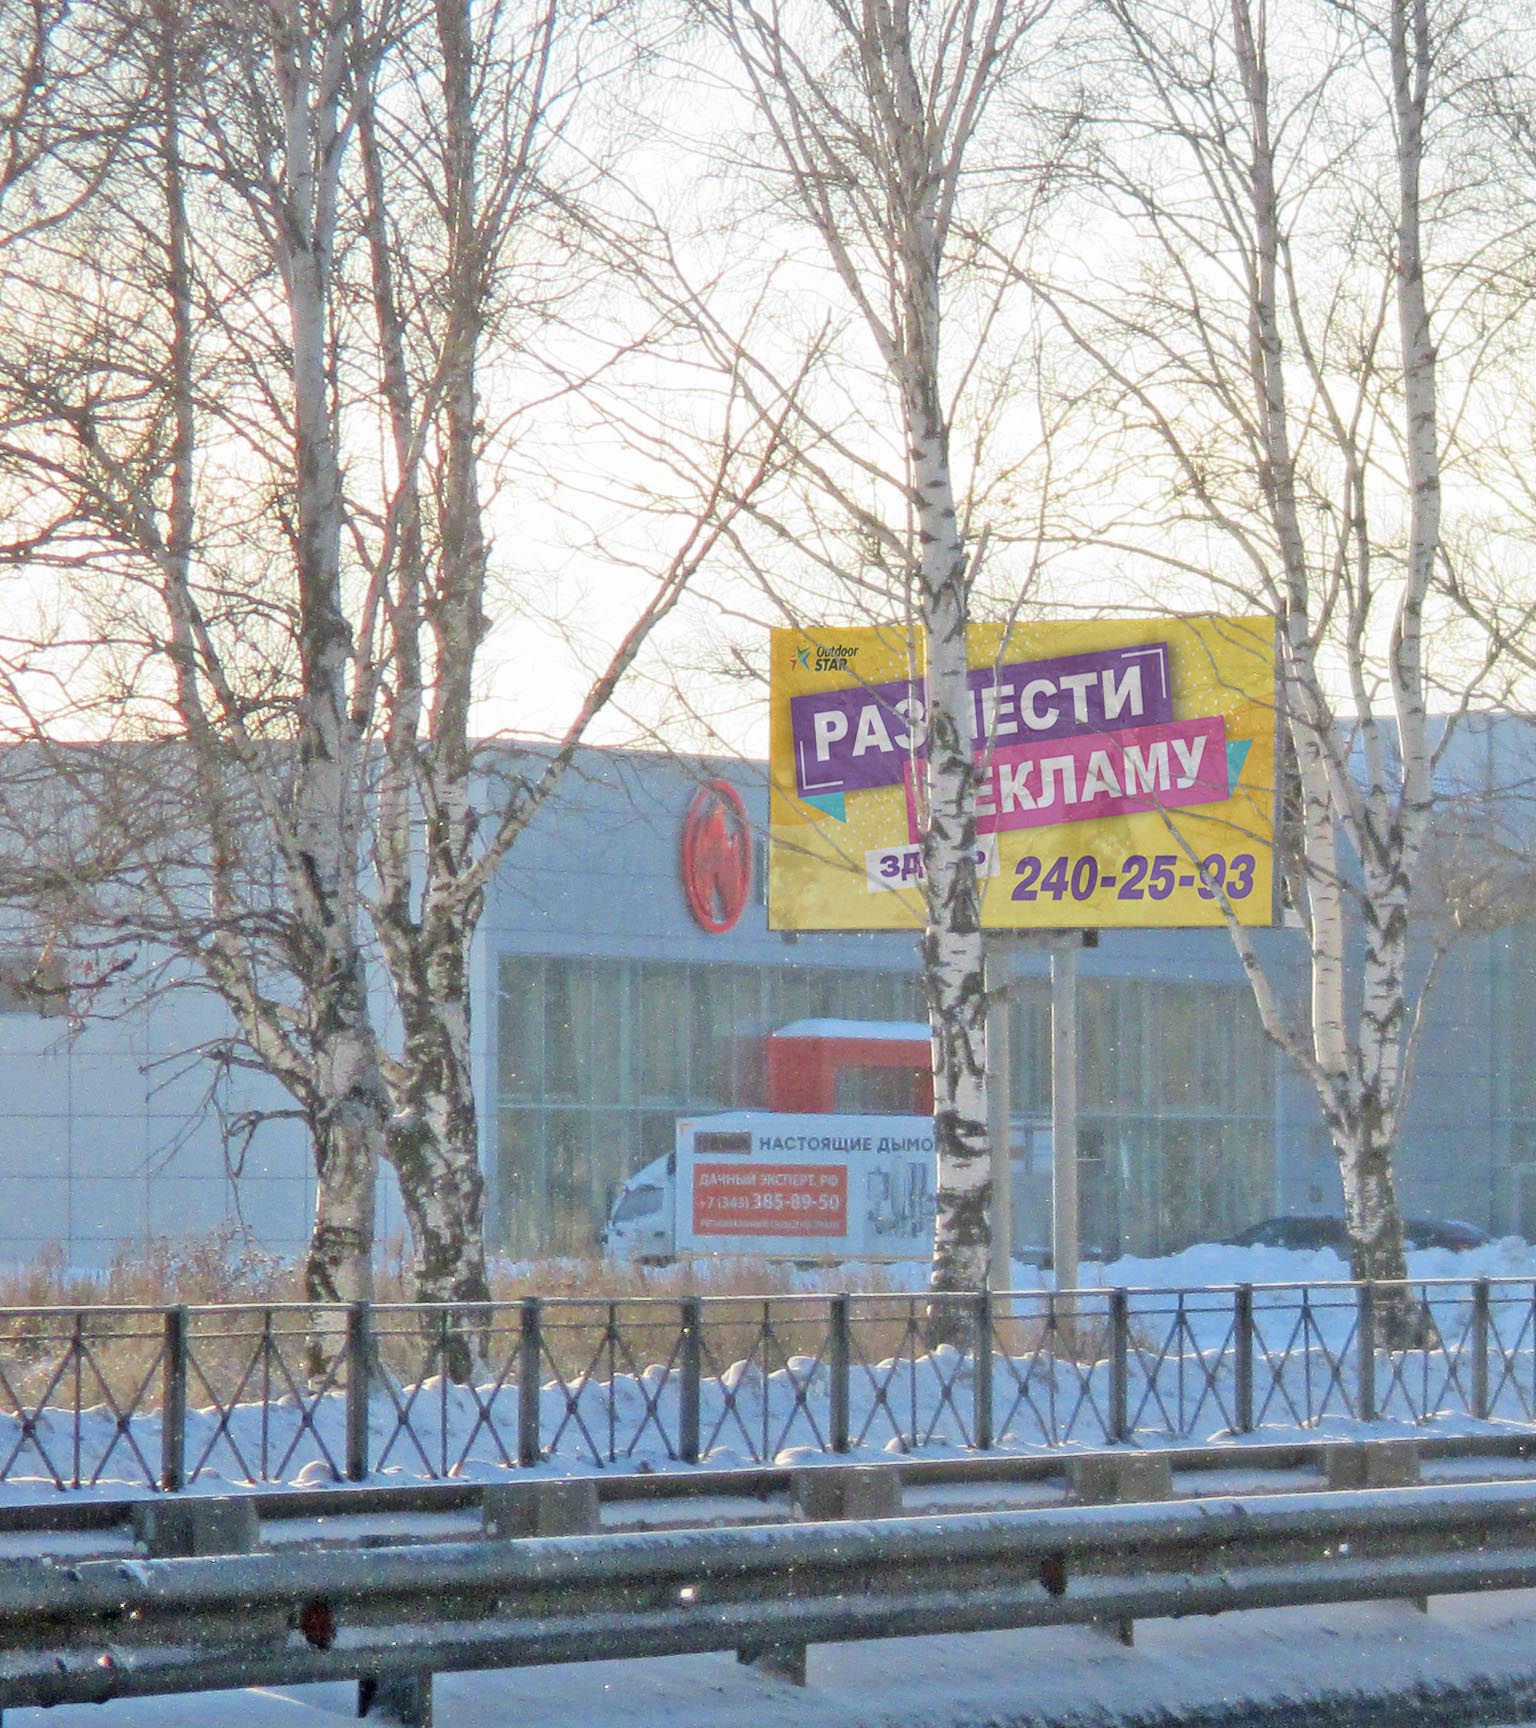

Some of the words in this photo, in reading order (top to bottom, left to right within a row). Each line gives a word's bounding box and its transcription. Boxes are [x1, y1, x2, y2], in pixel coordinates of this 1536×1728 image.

[816, 645, 859, 657] Outdoor
[815, 658, 848, 671] STAR
[972, 736, 1208, 817] ЕКЛАМУ
[1011, 853, 1256, 900] 240-25-93
[760, 1137, 872, 1153] НАСТОЯЩИЕ
[699, 1172, 756, 1187] ДАЧНЫЙ
